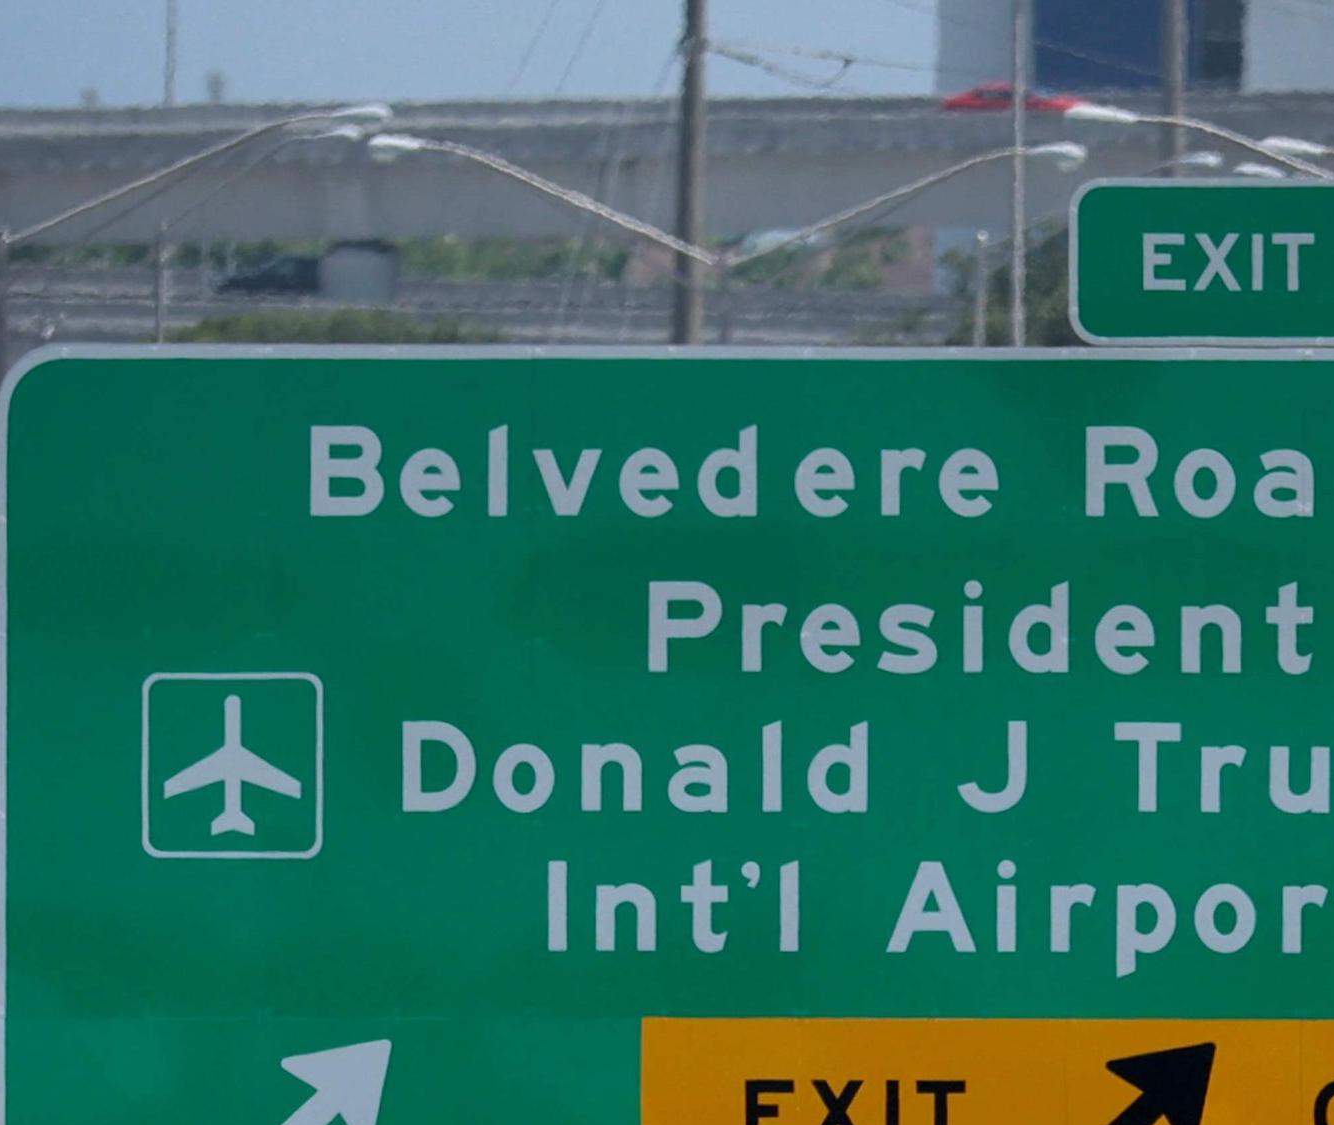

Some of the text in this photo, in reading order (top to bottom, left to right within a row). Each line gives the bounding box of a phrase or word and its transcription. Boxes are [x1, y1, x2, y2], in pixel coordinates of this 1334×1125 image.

[1143, 233, 1315, 291] EXIT
[310, 425, 999, 517] Belvedere
[648, 580, 1314, 674] President
[402, 720, 868, 813] Donald
[958, 720, 1028, 813] J
[548, 860, 800, 952] Int'l
